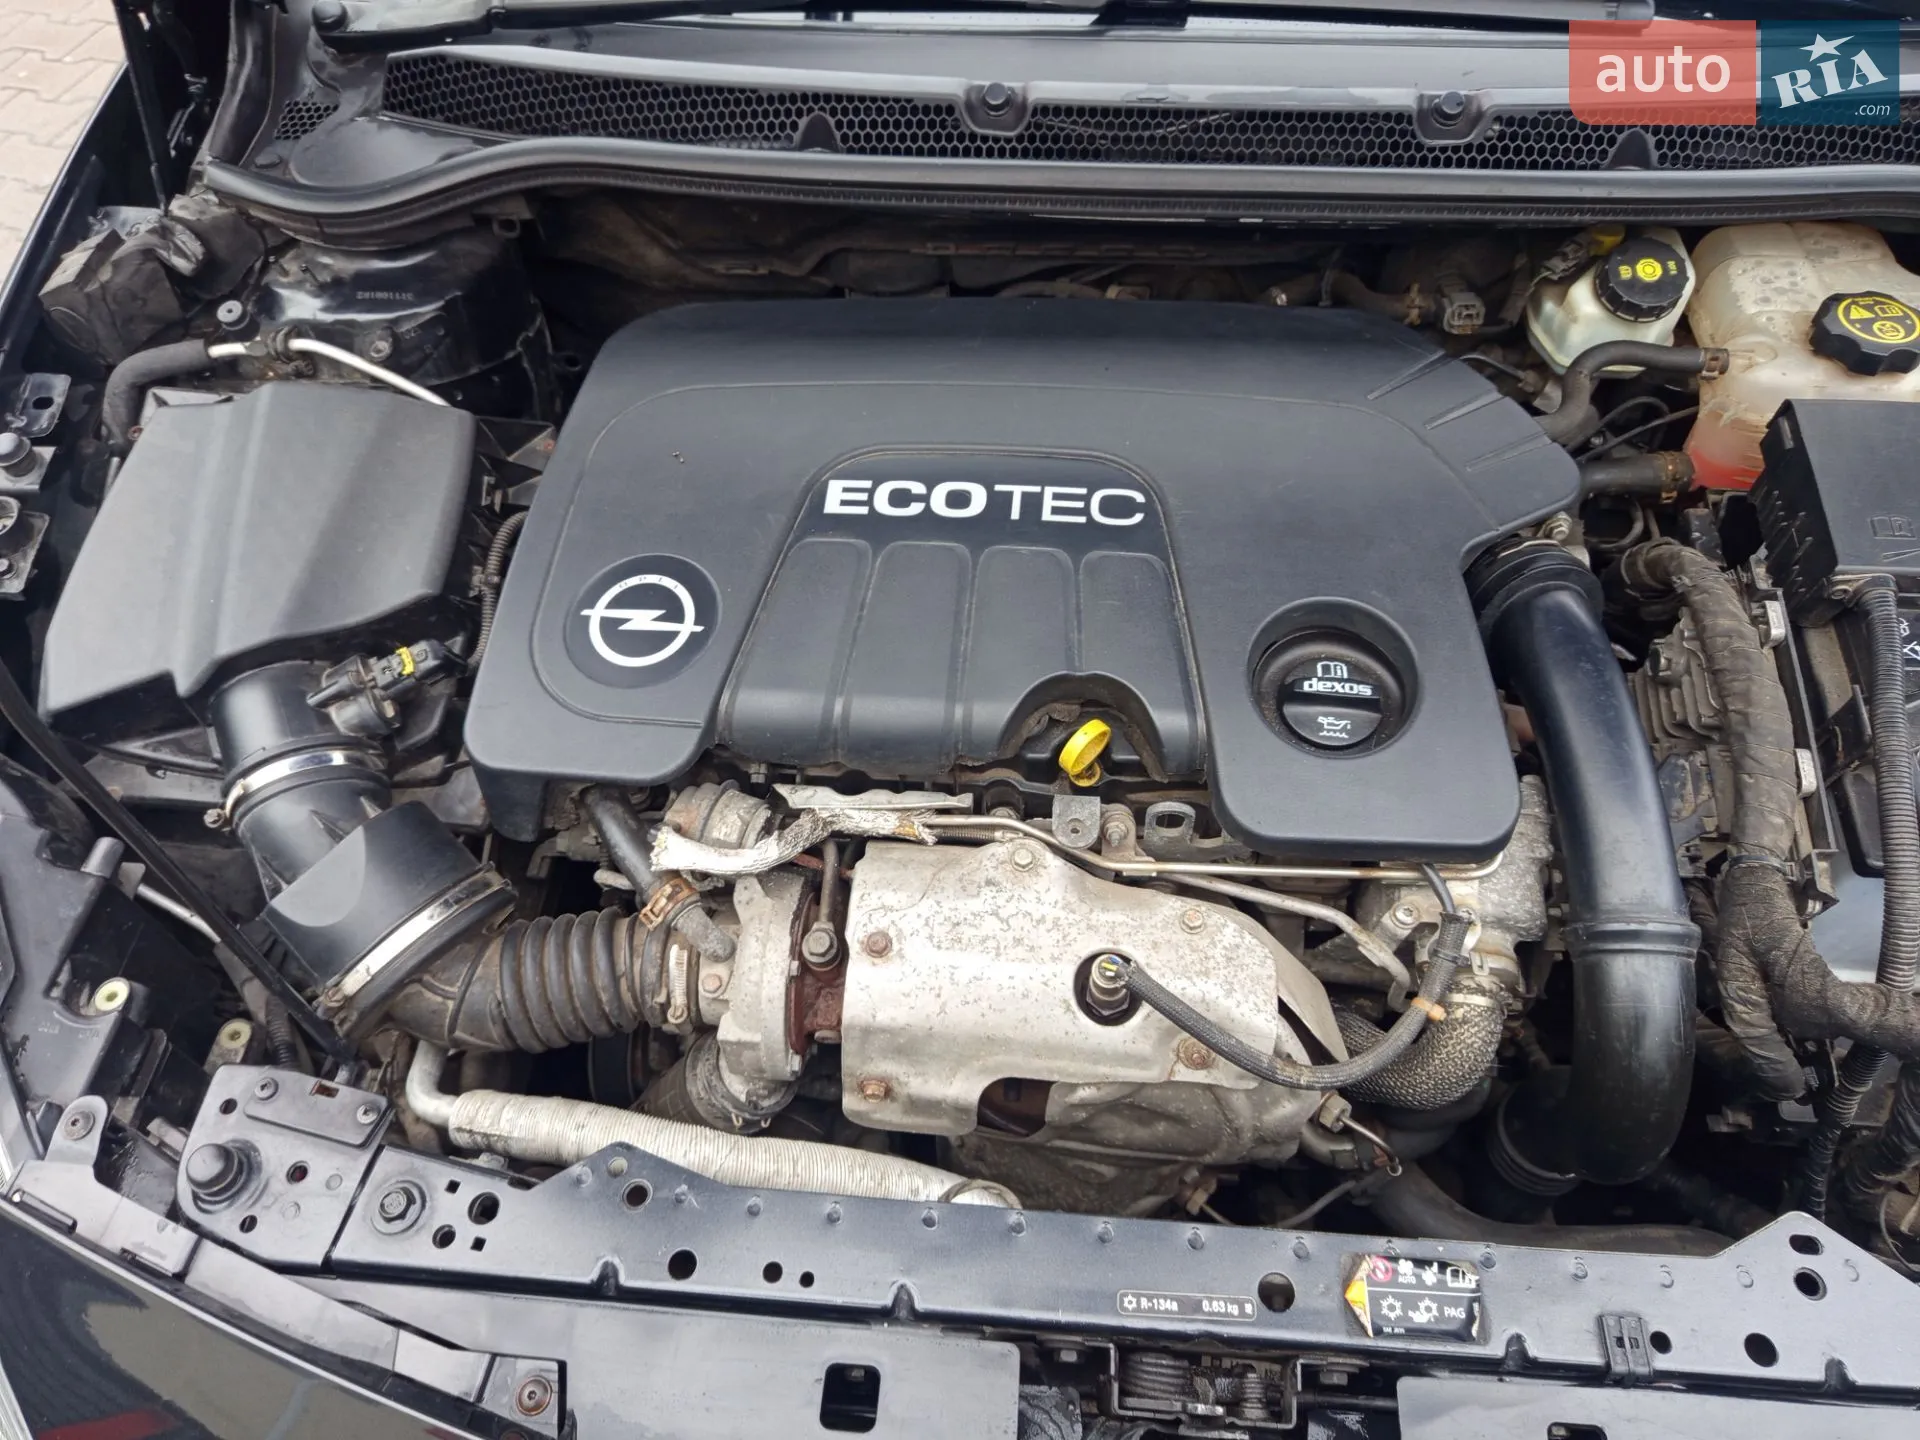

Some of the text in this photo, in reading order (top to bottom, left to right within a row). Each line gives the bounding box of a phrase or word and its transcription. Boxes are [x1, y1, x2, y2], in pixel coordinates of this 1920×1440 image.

[823, 479, 1146, 526] ECOTEC
[1303, 677, 1374, 696] dexos
[1398, 1275, 1417, 1285] AUTO
[1140, 1298, 1179, 1312] R-134a
[1443, 1306, 1466, 1319] PAG
